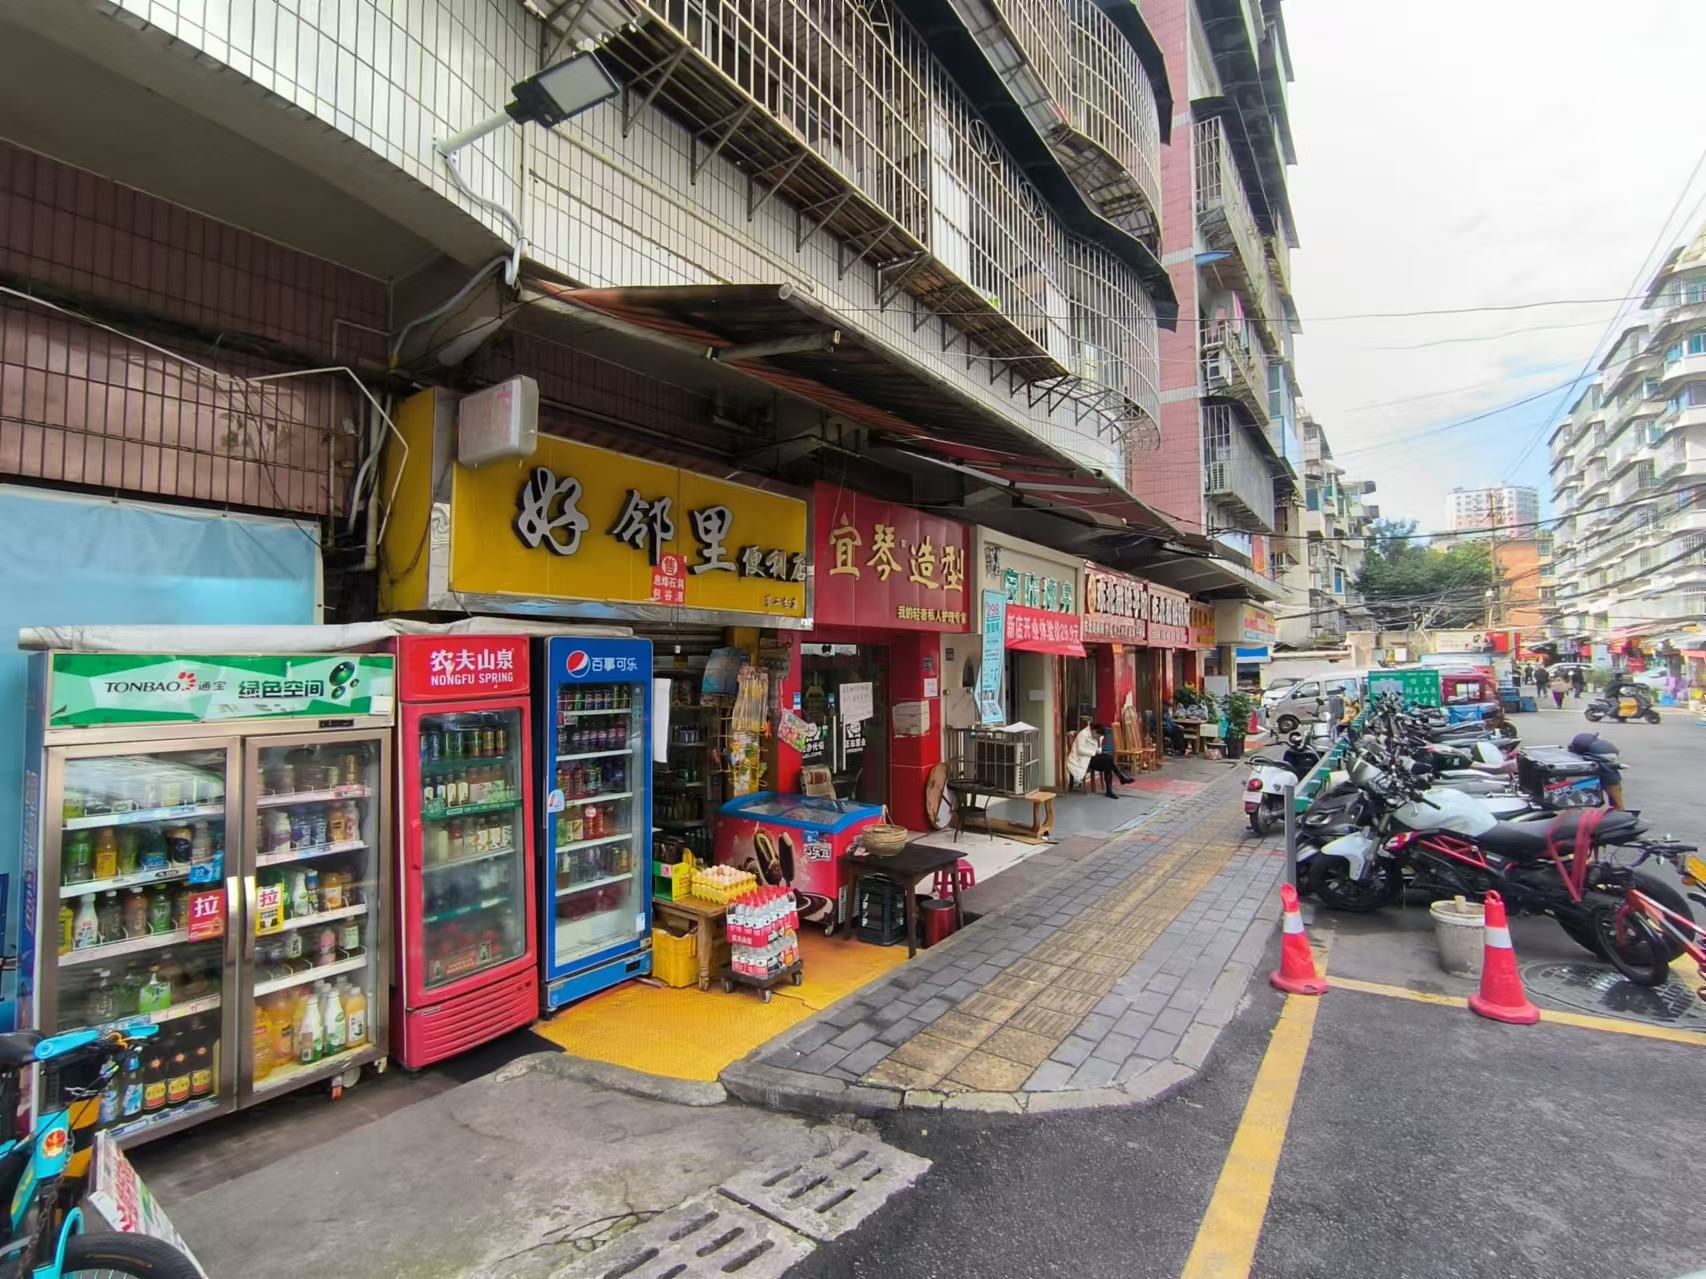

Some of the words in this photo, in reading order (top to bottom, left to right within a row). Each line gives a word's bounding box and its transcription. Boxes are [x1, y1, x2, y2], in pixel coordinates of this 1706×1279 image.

[513, 466, 737, 575] 好邻里
[828, 511, 964, 592] 宜琴造型
[663, 557, 677, 574] 售
[741, 545, 807, 582] 便利店
[430, 648, 514, 672] 农夫山泉
[591, 657, 638, 672] 百事可乐
[105, 681, 181, 693] TONBAO
[198, 680, 227, 692] 通宝
[430, 673, 475, 686] NONGFU
[478, 671, 514, 684] SPRING
[237, 680, 325, 699] 绿色空间
[194, 895, 220, 918] 拉
[260, 890, 279, 908] 拉
